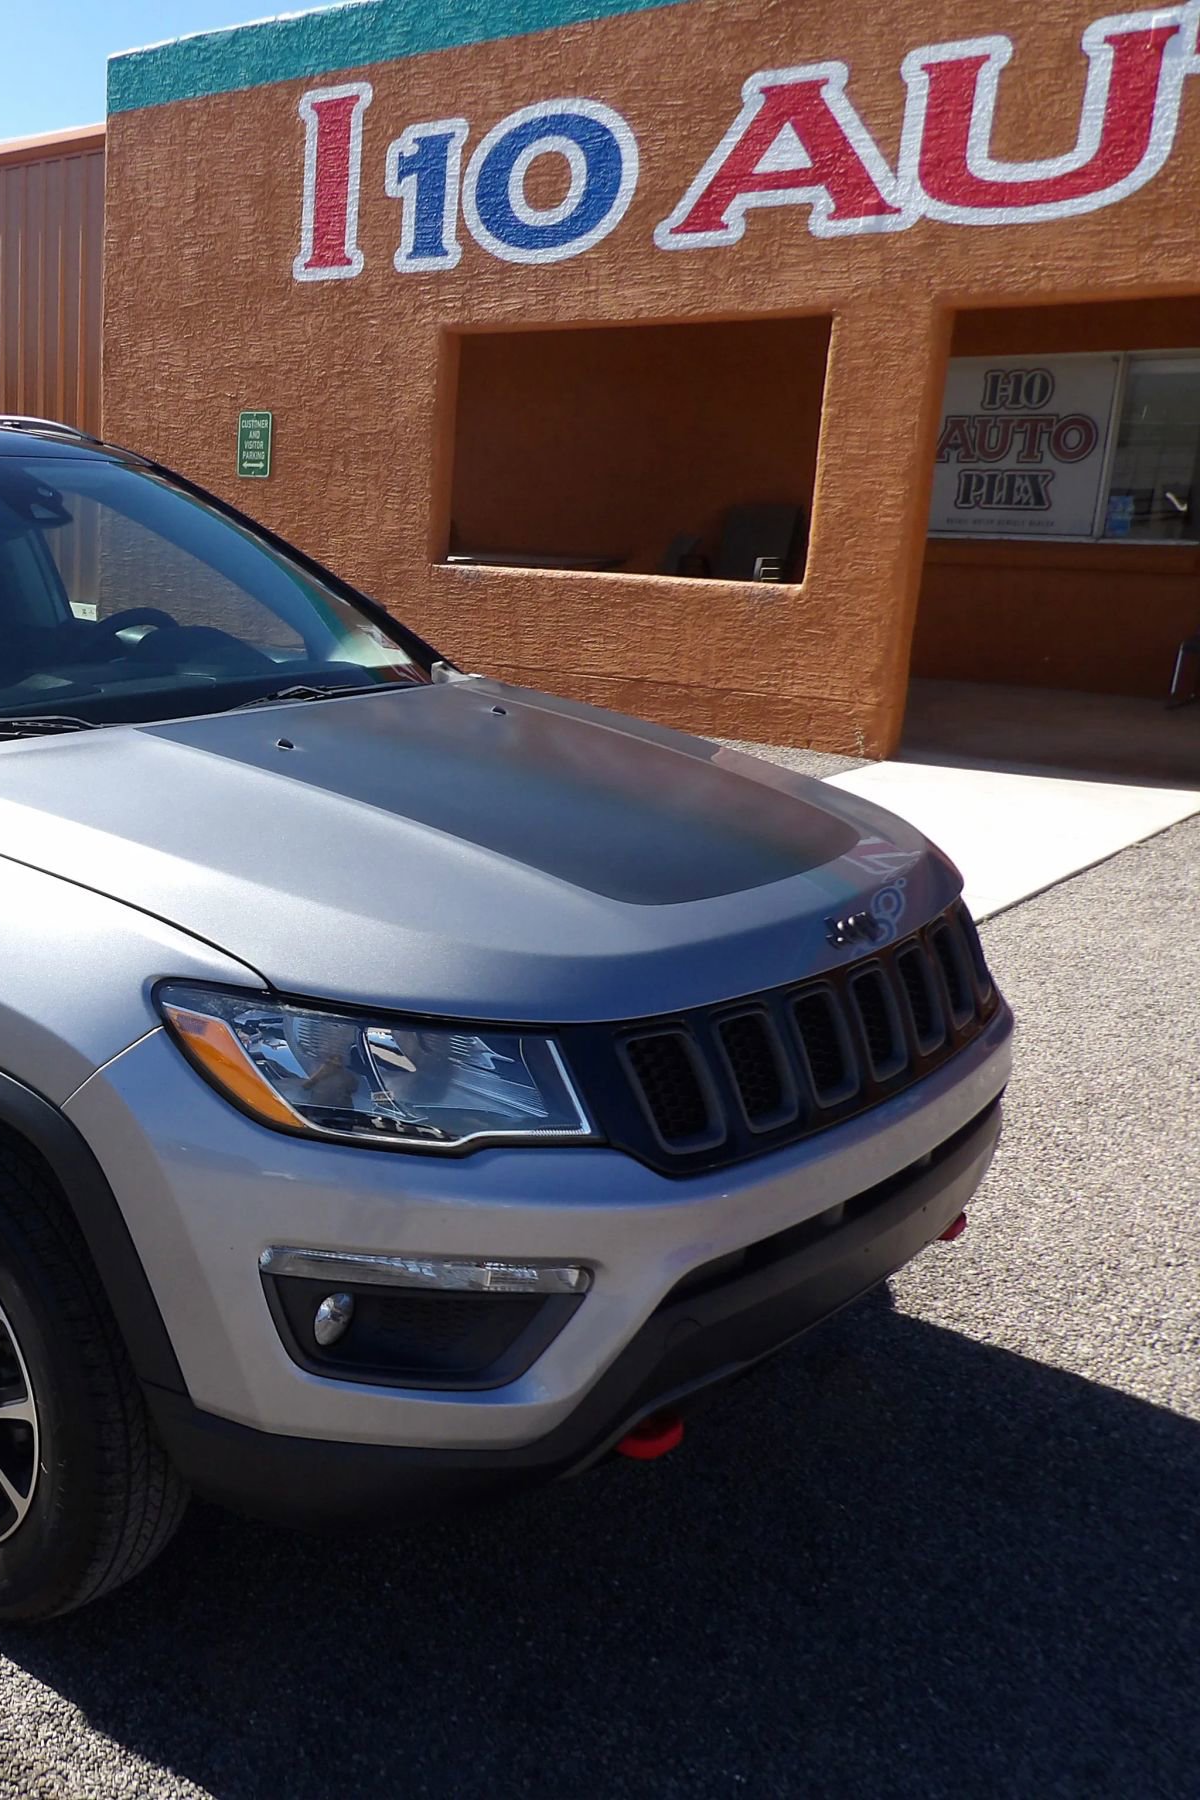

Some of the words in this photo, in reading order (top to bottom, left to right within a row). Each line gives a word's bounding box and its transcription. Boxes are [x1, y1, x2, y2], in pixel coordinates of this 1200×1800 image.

[654, 0, 1200, 250] AU
[241, 420, 268, 428] CUSTOMER
[248, 431, 260, 439] AND
[936, 414, 1098, 463] AUTO
[244, 441, 264, 449] VISITOR
[242, 451, 265, 460] PARKING
[955, 470, 1054, 510] PLEX
